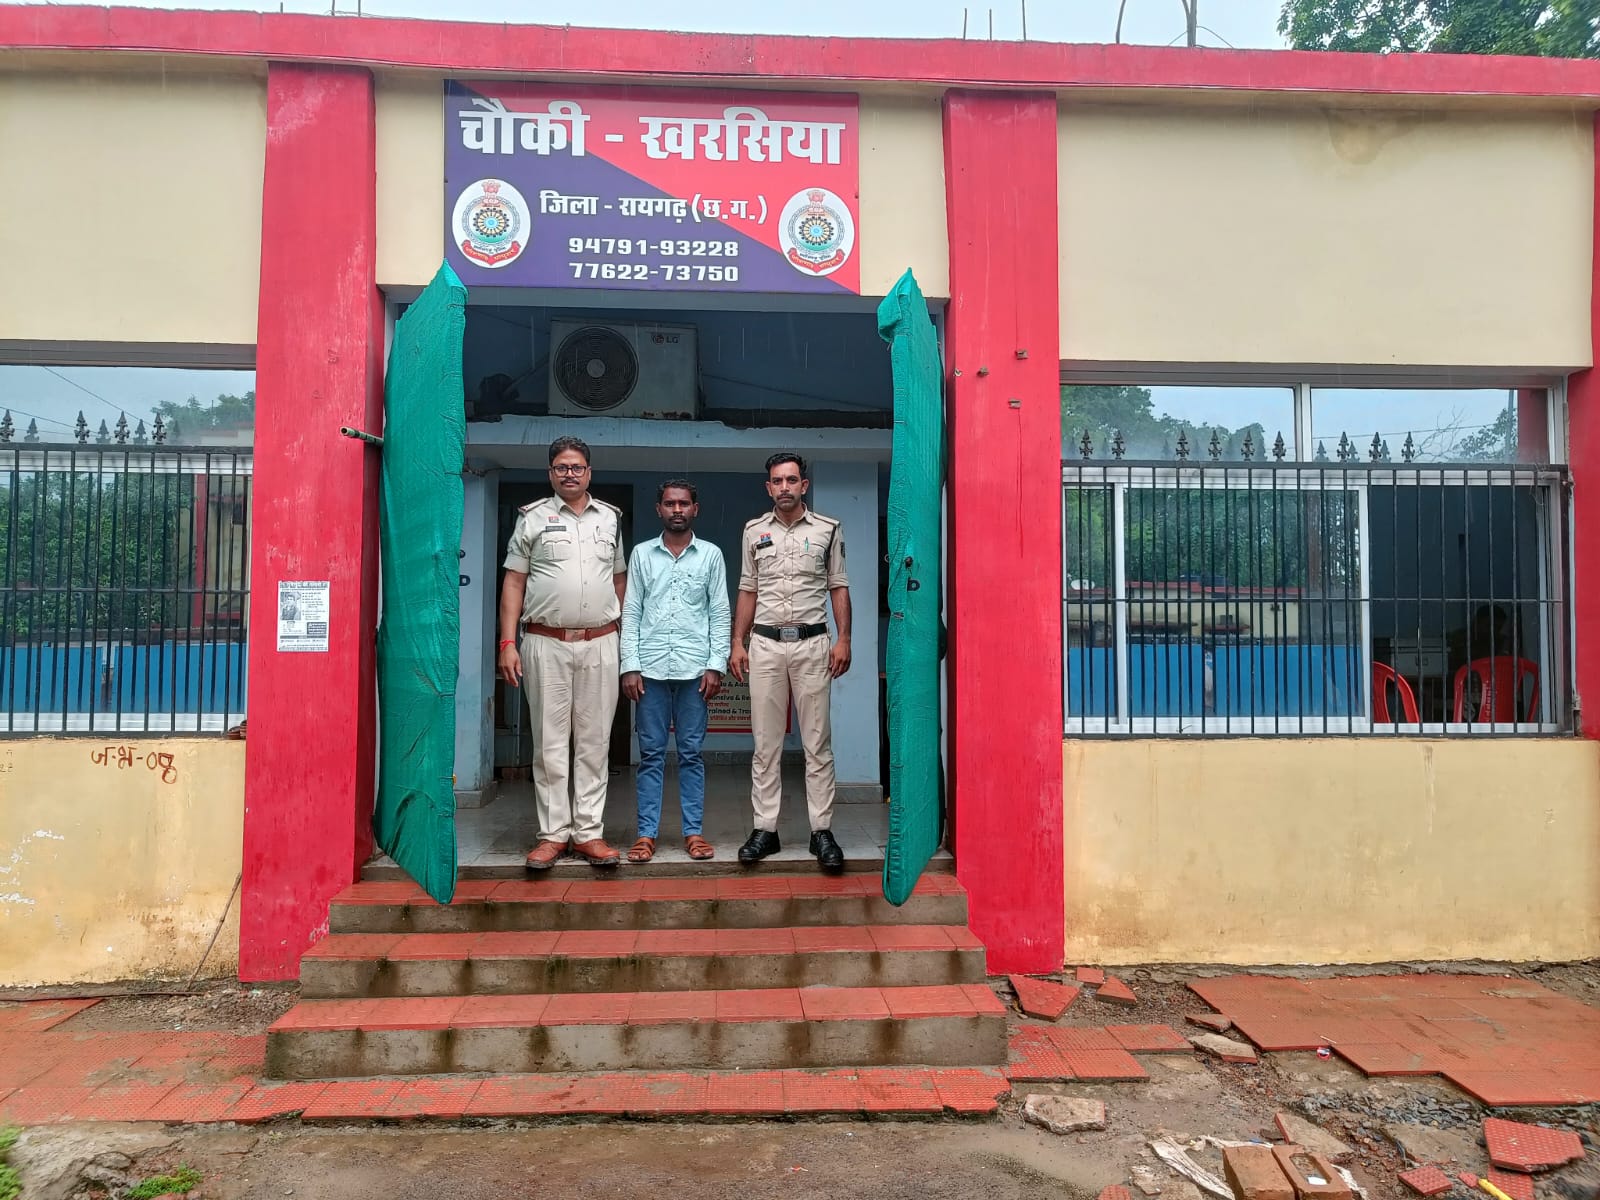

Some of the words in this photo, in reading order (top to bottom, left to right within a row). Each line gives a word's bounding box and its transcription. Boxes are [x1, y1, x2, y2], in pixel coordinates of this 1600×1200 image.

[459, 97, 590, 157] चौकी
[638, 106, 846, 164] खरसिया
[539, 189, 599, 215] जिला
[568, 237, 739, 257] 94791-93228
[568, 262, 739, 282] 77622-73750
[666, 335, 679, 344] LG
